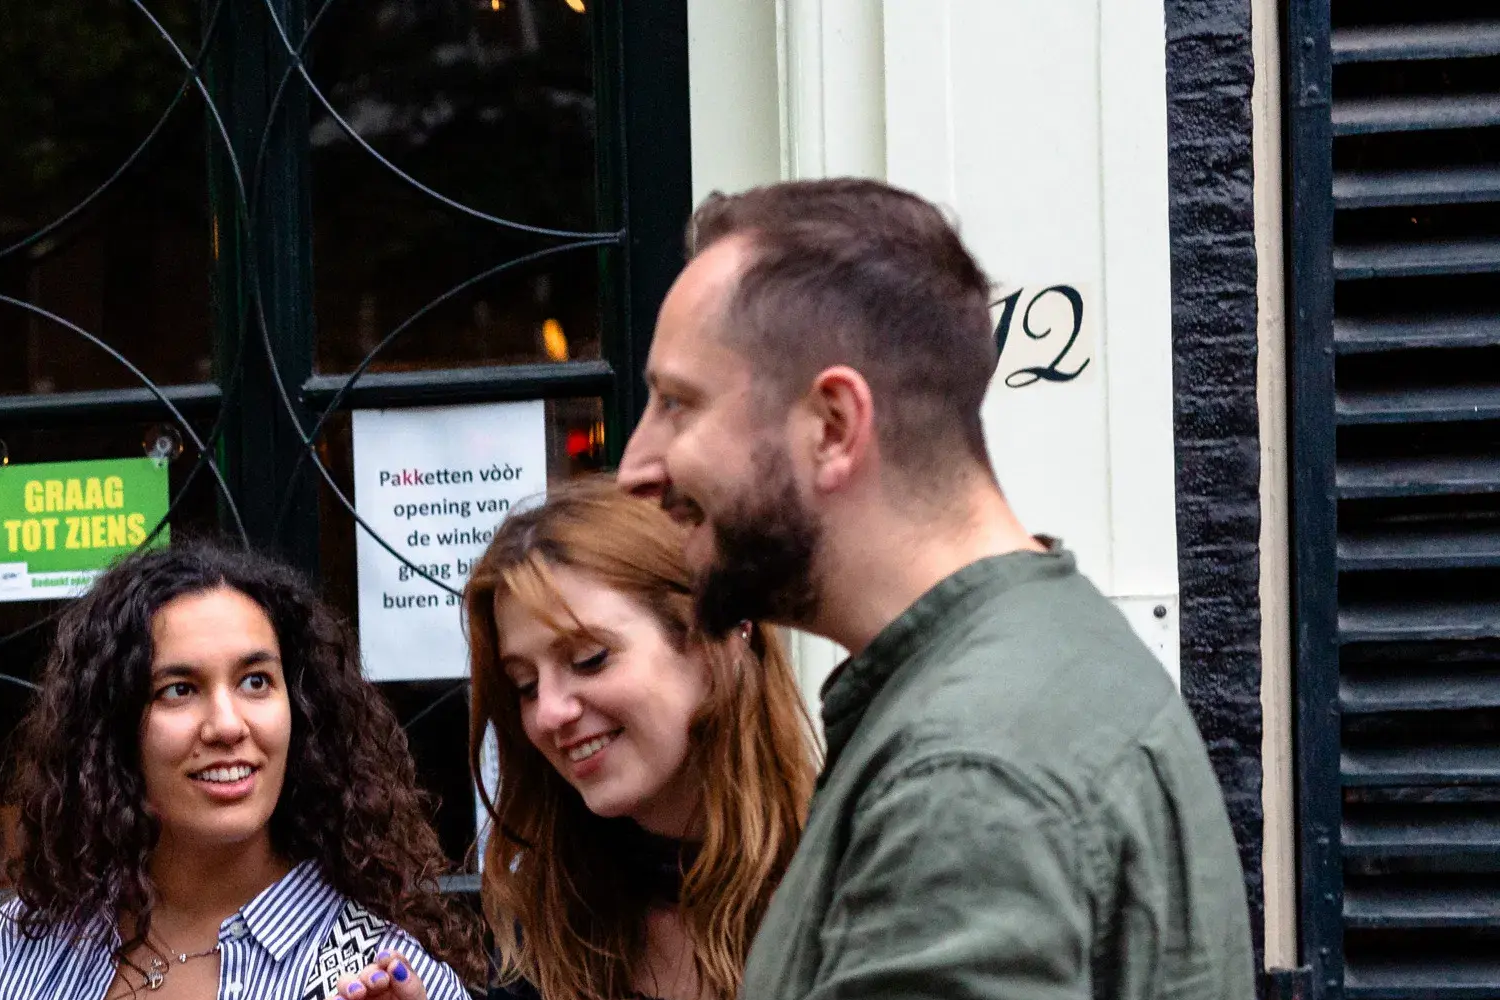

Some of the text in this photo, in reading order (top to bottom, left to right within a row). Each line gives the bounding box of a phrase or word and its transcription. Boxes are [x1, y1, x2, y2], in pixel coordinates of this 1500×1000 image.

[988, 285, 1090, 388] 12
[379, 468, 473, 487] Pakketten
[24, 476, 124, 513] GRAAG
[393, 498, 510, 520] opening van
[4, 513, 147, 553] TOT ZIENS
[407, 529, 431, 547] de
[398, 563, 451, 581] graag
[382, 592, 439, 609] buren
